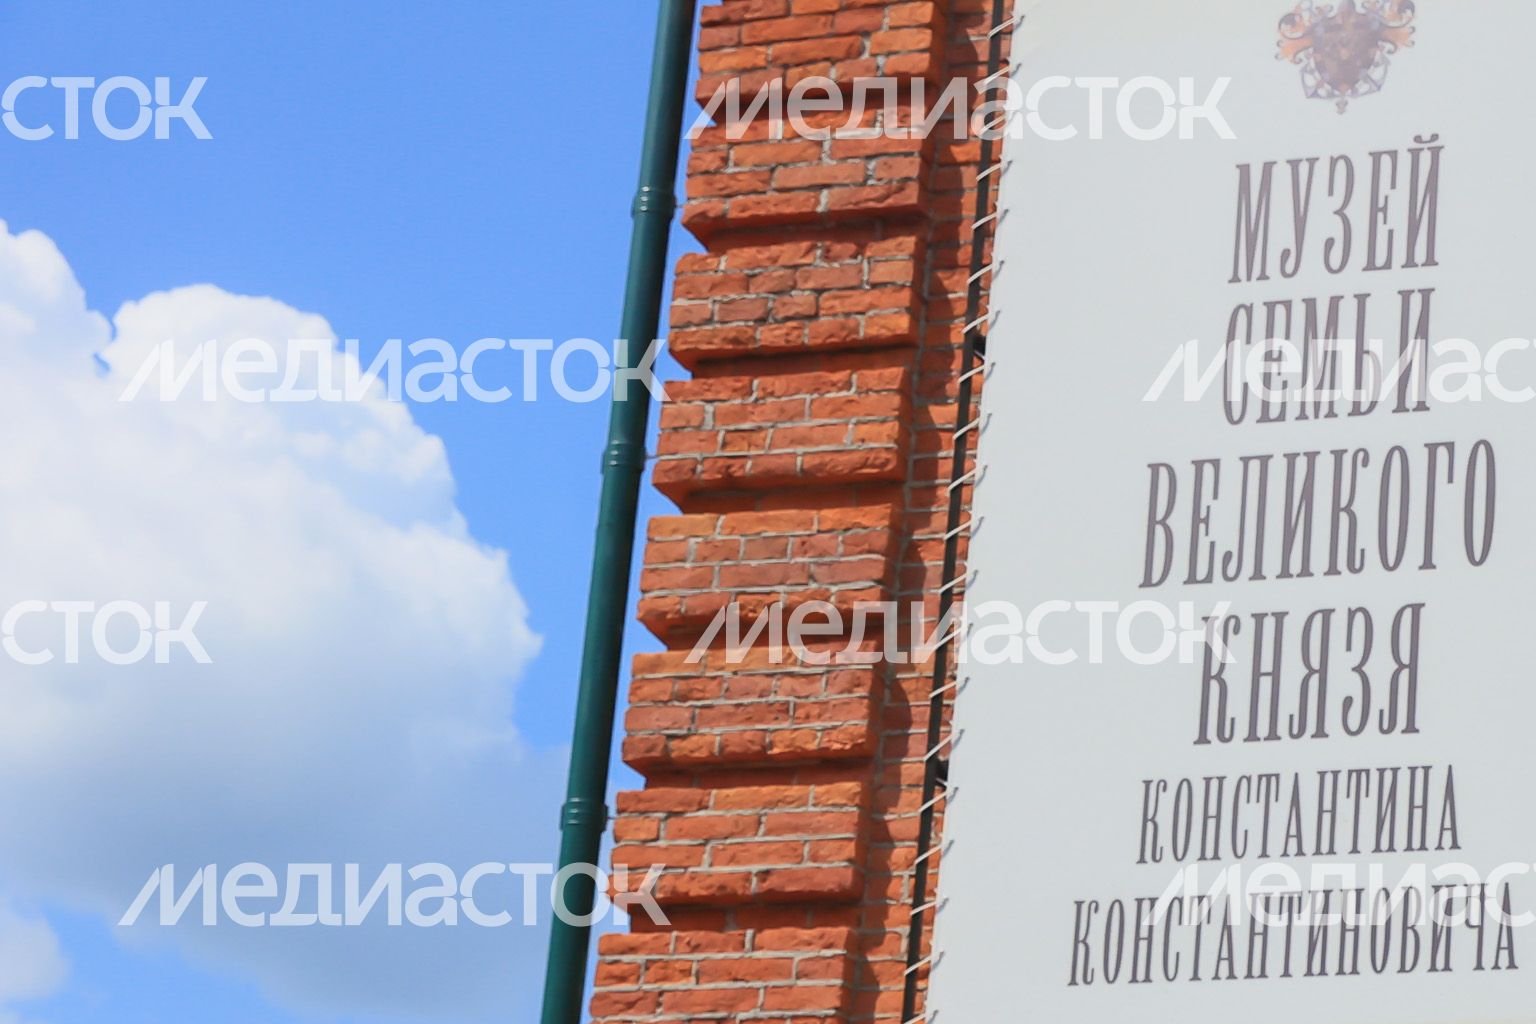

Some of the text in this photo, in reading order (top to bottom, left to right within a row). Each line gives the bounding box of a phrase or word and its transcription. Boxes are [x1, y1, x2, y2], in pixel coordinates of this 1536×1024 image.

[1228, 133, 1445, 284] МУЗЕЙ
[1222, 287, 1436, 427] СЕМЬИ
[1138, 438, 1498, 589] ВЕЛИКОГО
[1192, 603, 1426, 745] КНЯЗЯ
[1135, 764, 1463, 864] КОНСТАНТИНА
[1067, 882, 1519, 986] КОНСТАНТИНОВИЧА
